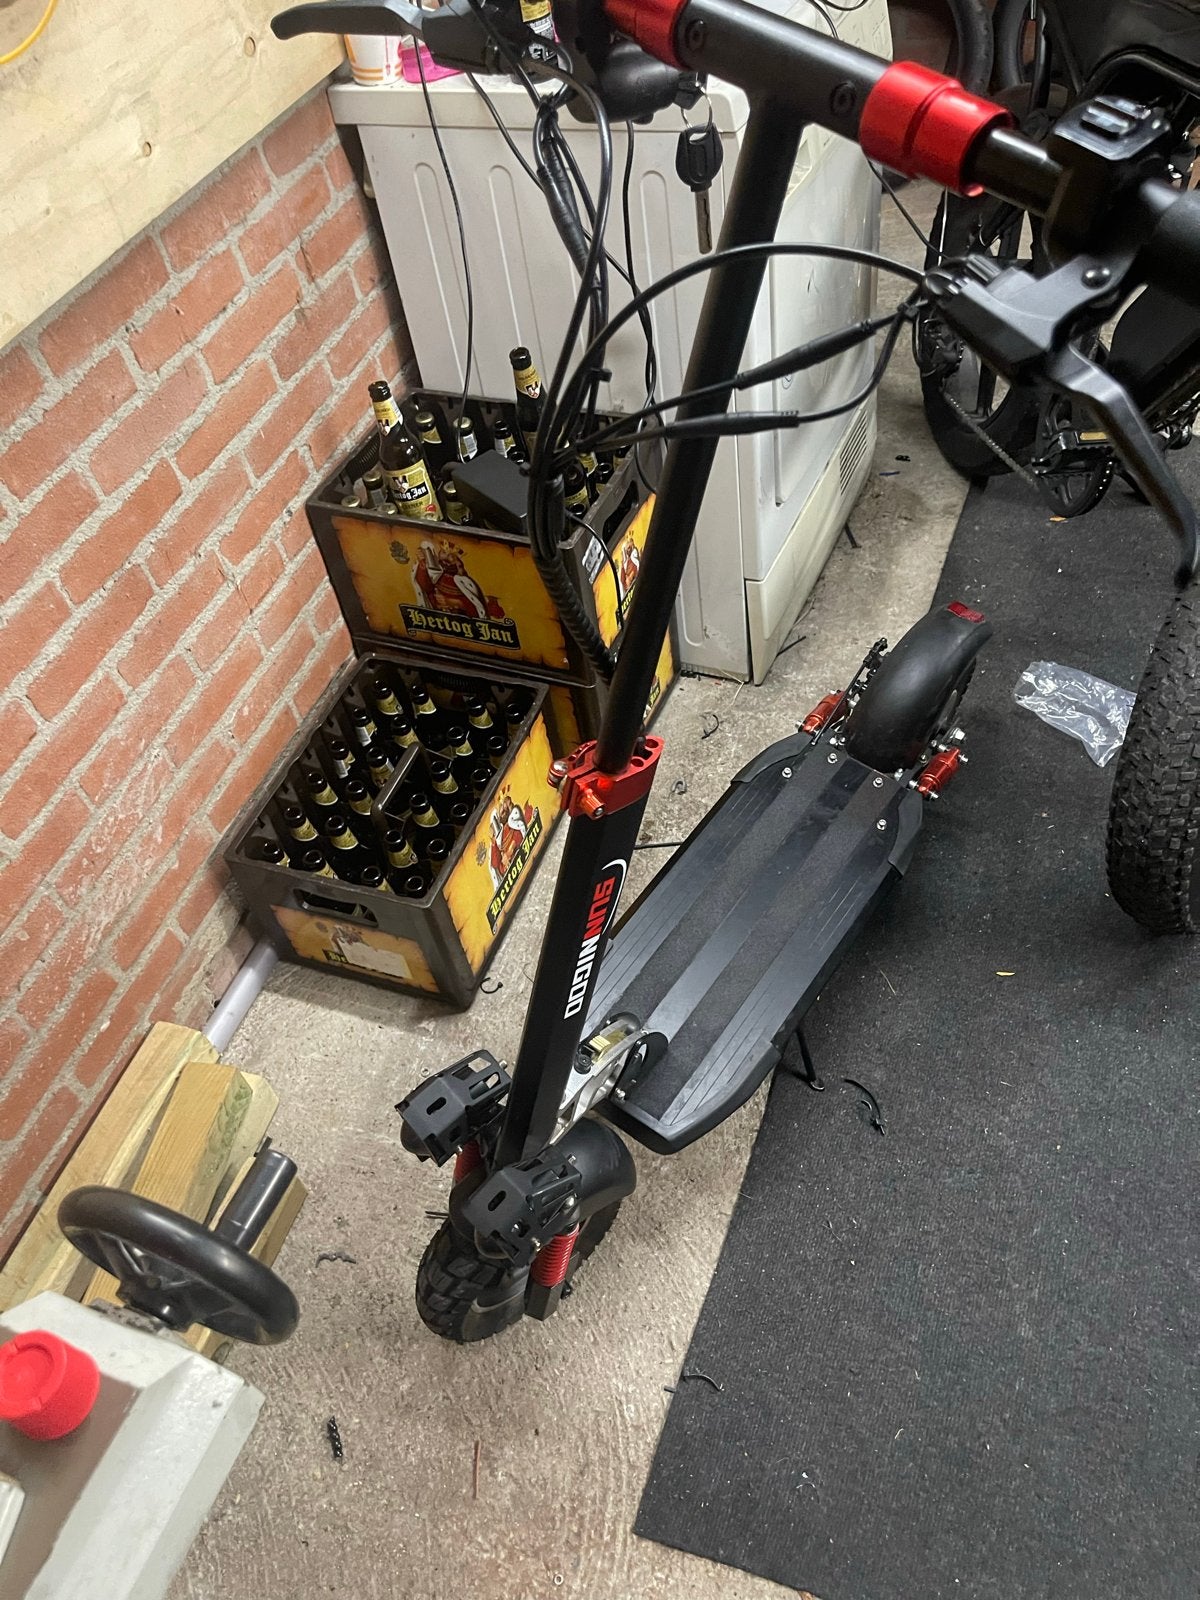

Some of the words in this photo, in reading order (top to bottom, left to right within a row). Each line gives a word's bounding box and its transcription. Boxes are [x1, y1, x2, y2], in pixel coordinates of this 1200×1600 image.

[407, 608, 473, 638] Hertog
[475, 621, 514, 644] Jan
[490, 855, 525, 920] Hertog
[521, 822, 541, 861] Jan
[563, 876, 616, 1020] SUNNIGOO
